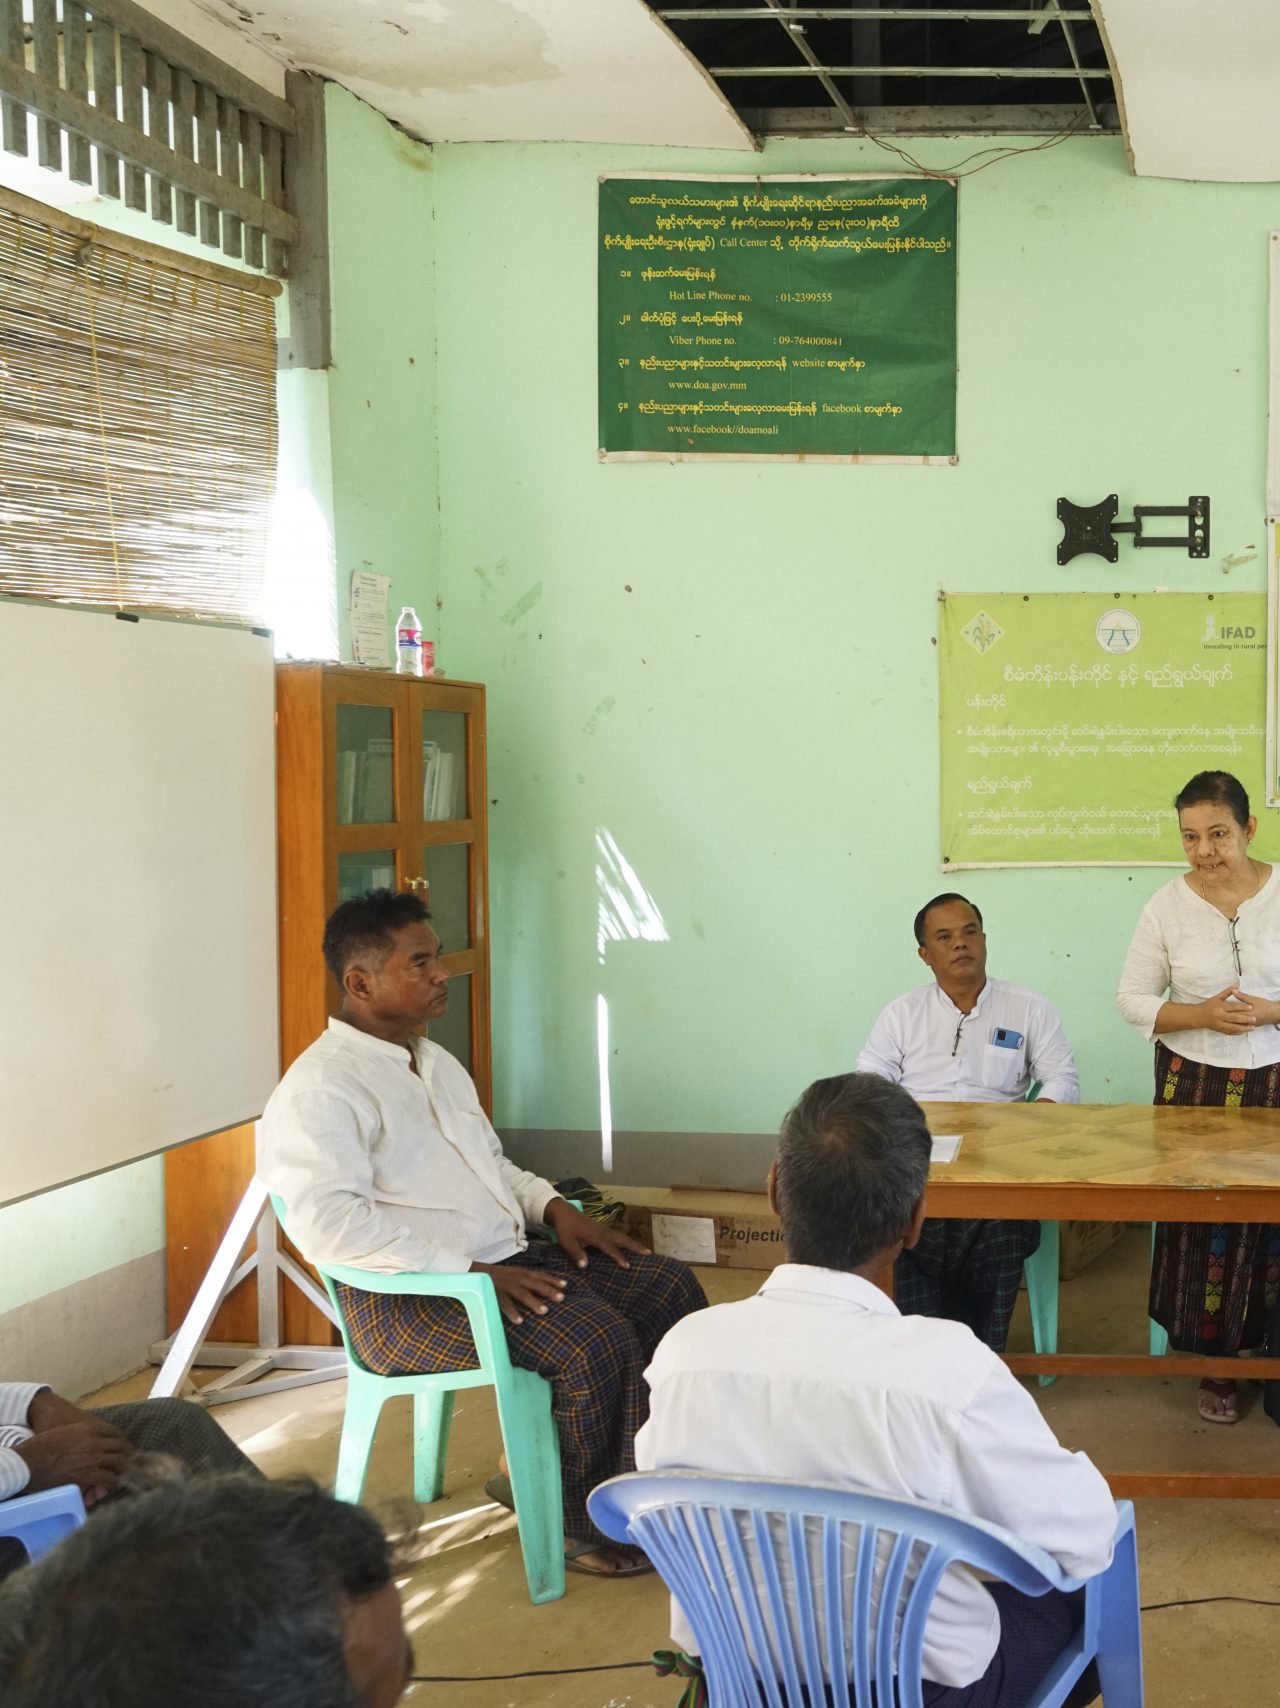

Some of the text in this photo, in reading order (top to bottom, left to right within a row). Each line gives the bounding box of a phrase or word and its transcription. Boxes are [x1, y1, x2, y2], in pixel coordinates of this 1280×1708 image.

[720, 237, 738, 248] Call
[739, 237, 768, 248] Center
[669, 290, 833, 302] Hot Line Phone no. 01-2399555
[669, 335, 842, 346] Viber Phone no. 09-764000841
[792, 358, 826, 368] website
[668, 380, 747, 392] www.doa.gov.mm
[822, 403, 862, 414] facebook
[1221, 626, 1256, 639] IFAD
[1003, 663, 1234, 688] စီမံကိန်းပန်းတိုင် နှင့် ရည်ရွယ်ချက်
[967, 776, 1033, 794] ရည်ရွယ်ချက်
